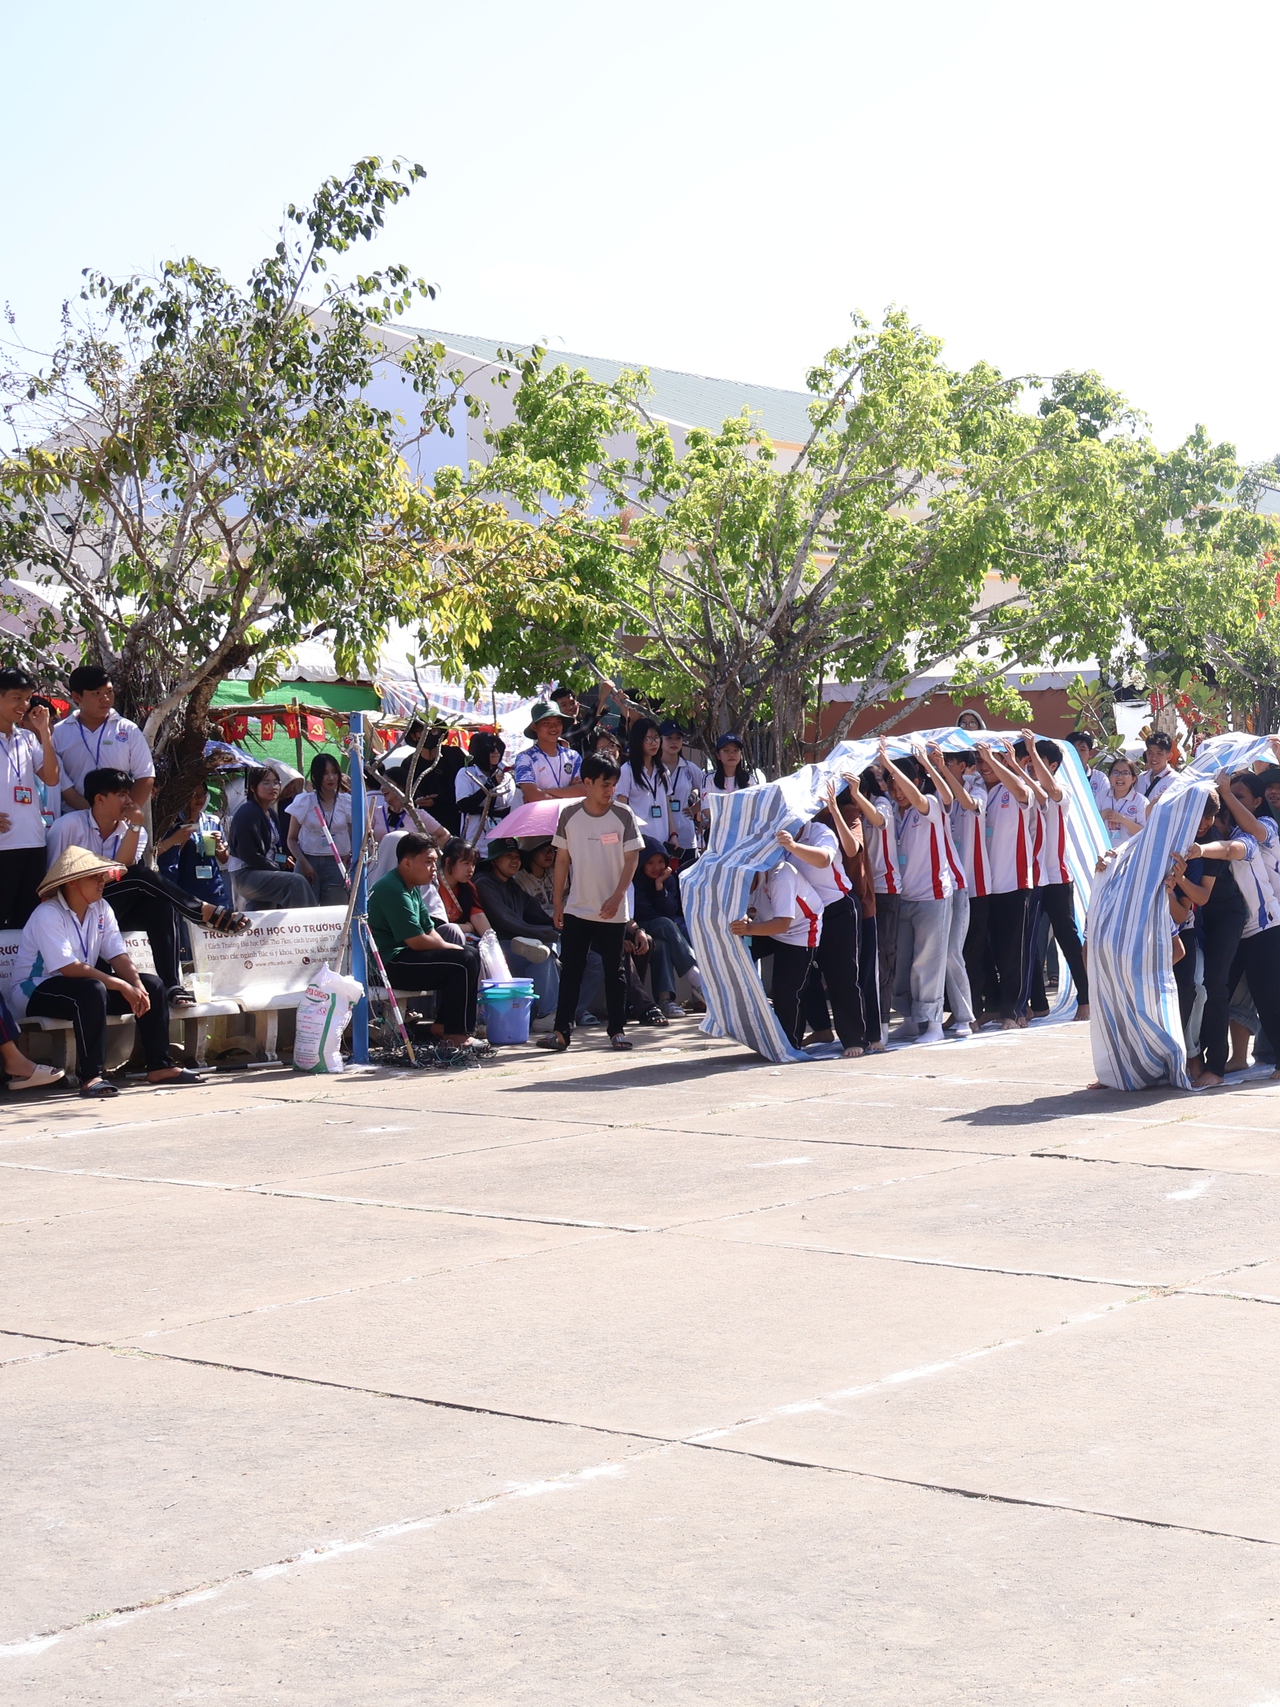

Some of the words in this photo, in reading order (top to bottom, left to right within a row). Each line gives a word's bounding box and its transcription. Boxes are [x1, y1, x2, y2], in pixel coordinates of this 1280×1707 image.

[246, 927, 264, 938] ĐẠI
[266, 926, 286, 936] HỌC
[303, 922, 342, 933] TRƯỜNG
